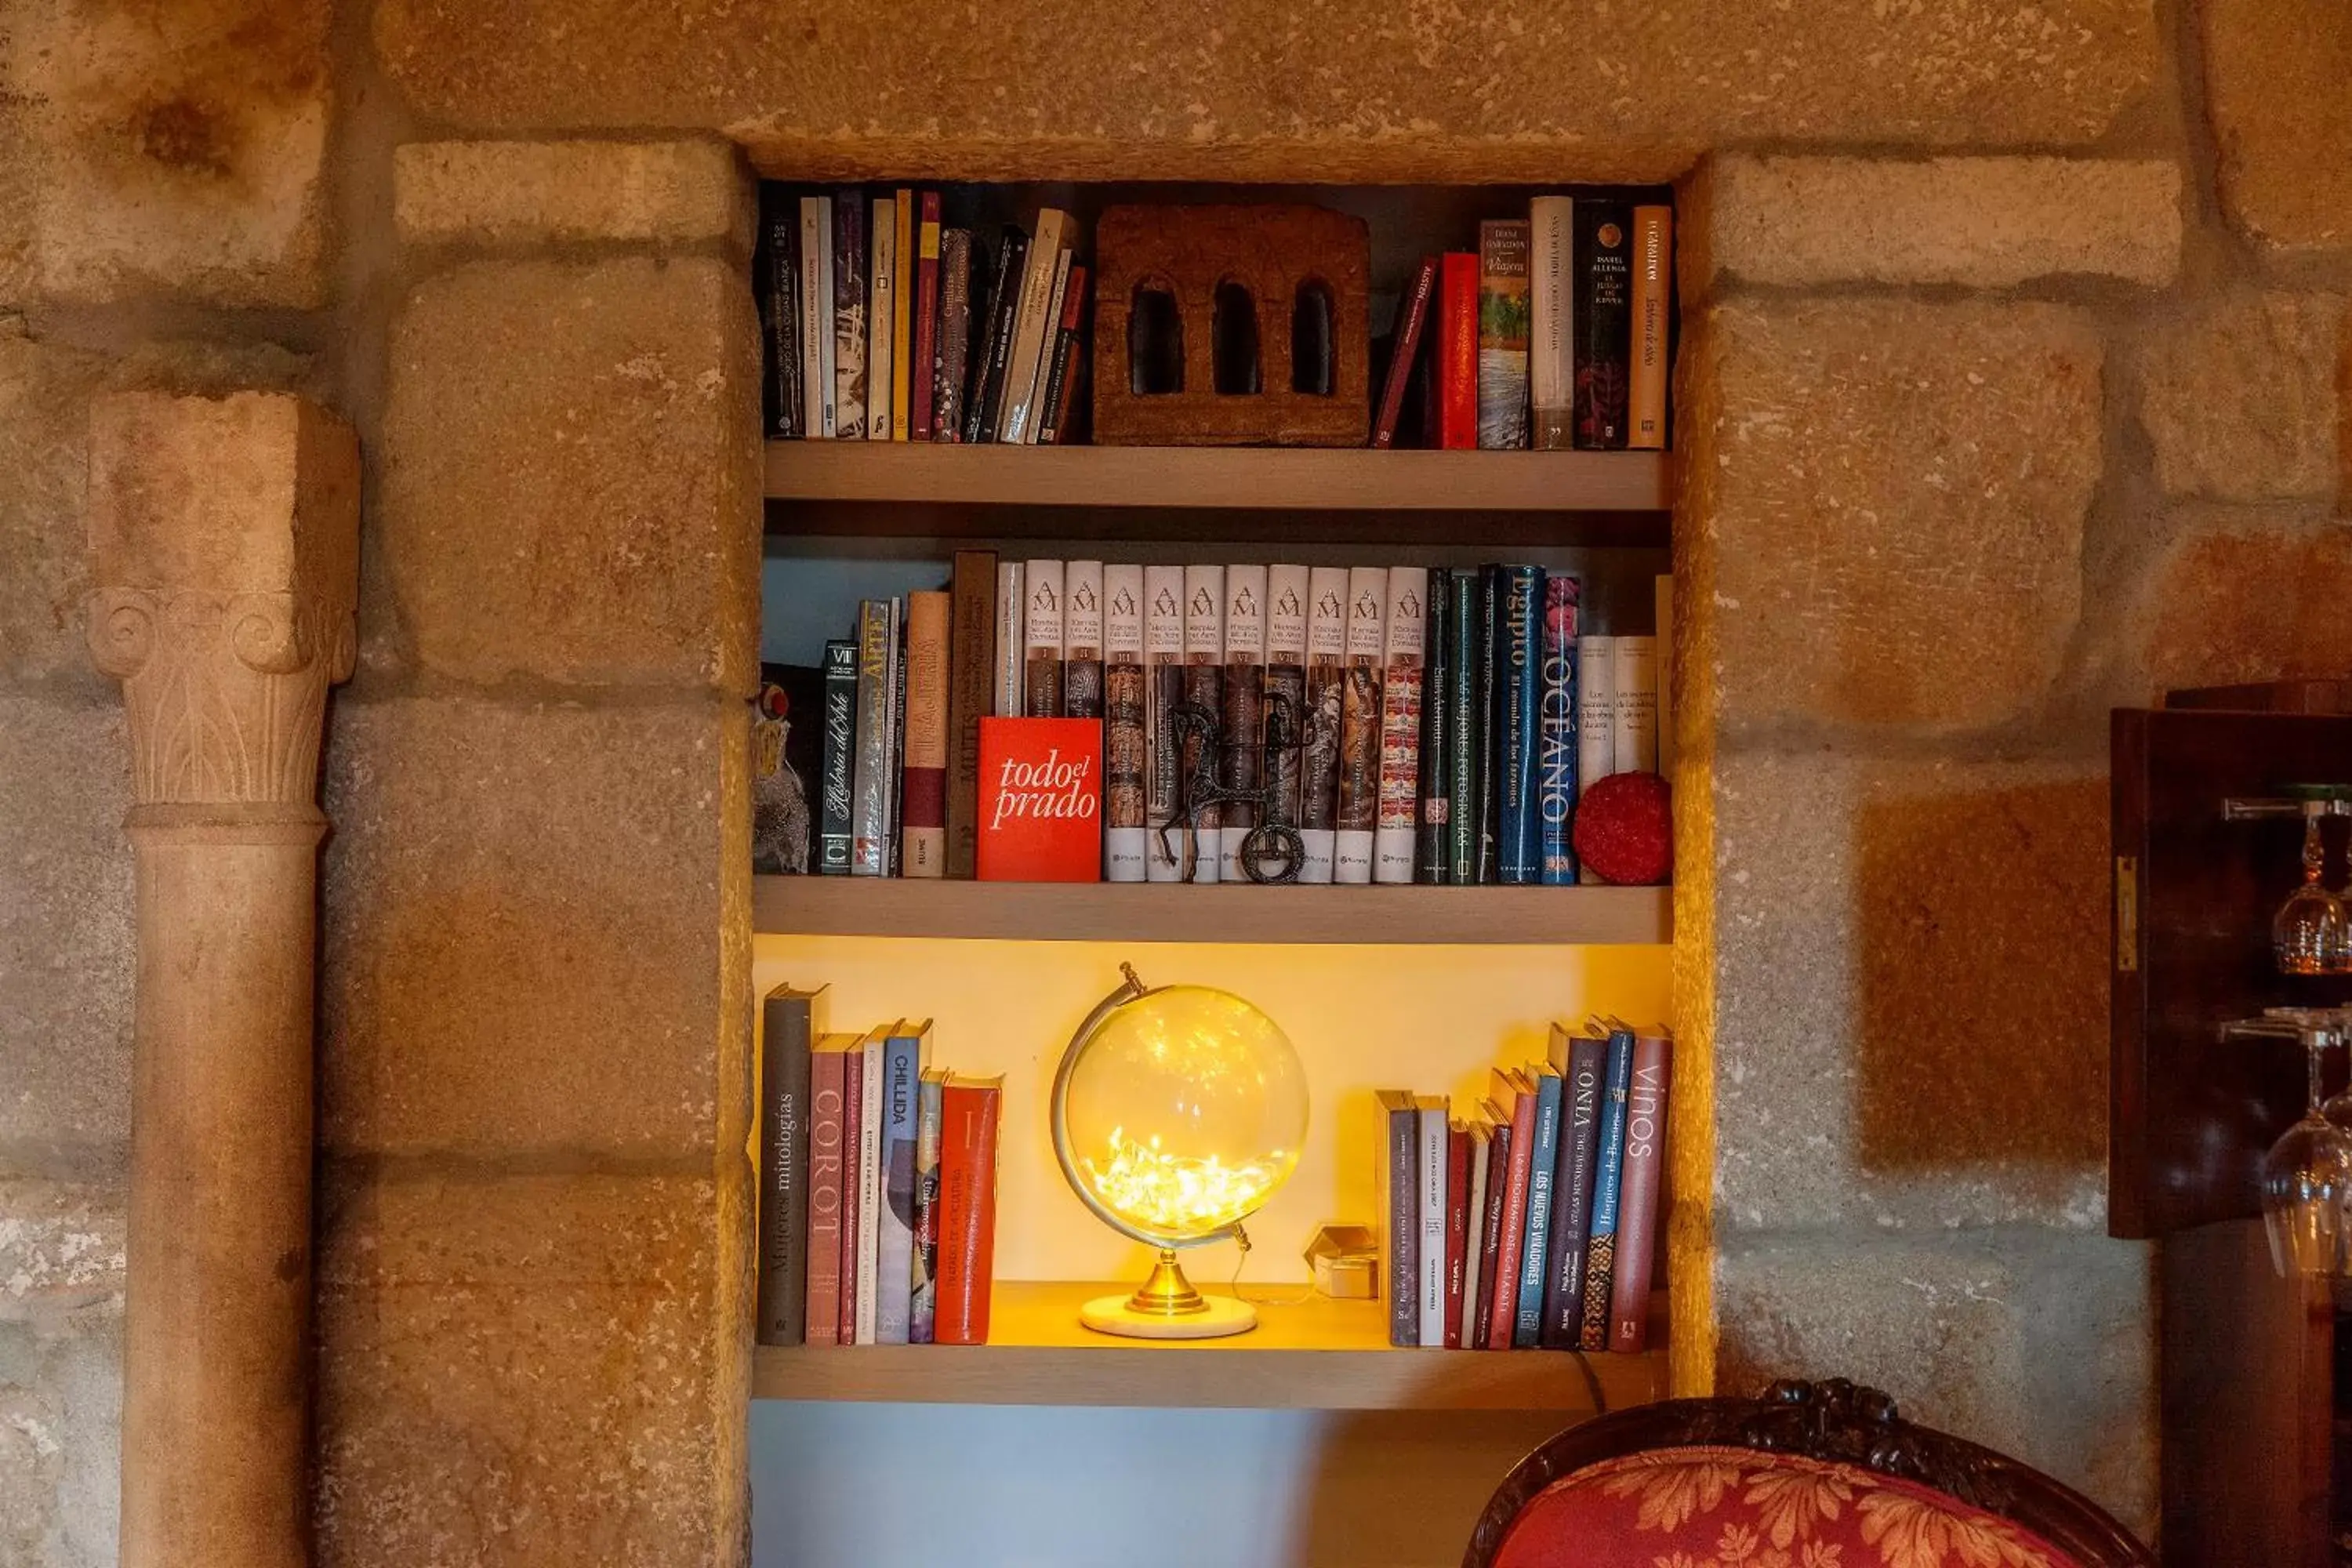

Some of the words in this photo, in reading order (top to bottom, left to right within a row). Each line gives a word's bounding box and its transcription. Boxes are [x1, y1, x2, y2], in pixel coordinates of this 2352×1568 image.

[1417, 266, 1430, 299] AUSTEN
[1507, 575, 1534, 666] Egipto
[863, 617, 885, 678] ARTE
[1118, 653, 1130, 662] III
[1358, 656, 1368, 665] IX
[1510, 676, 1519, 687] El
[829, 691, 851, 731] Arte
[1458, 696, 1470, 751] MEJORES
[1510, 690, 1520, 726] mundo
[829, 730, 849, 750] del
[1510, 729, 1520, 741] de
[1510, 744, 1520, 760] los
[1542, 655, 1576, 823] OCÉANO
[826, 753, 851, 820] Historia
[1000, 748, 1073, 787] todo
[1073, 755, 1091, 776] el
[989, 780, 1095, 830] prado
[1458, 754, 1472, 839] FOTOGRAFÍAS
[893, 1054, 909, 1125] CHILLIDA
[1573, 1071, 1594, 1128] VINO
[1629, 1065, 1665, 1157] vinos
[775, 1092, 796, 1190] mitologías
[1577, 1133, 1586, 1151] DEL
[812, 1089, 843, 1241] COROT
[1536, 1171, 1548, 1189] LOS
[1573, 1152, 1584, 1195] MUNDIAL
[1533, 1192, 1546, 1229] NUEVOS
[1570, 1196, 1581, 1227] ATLAS
[773, 1196, 793, 1273] Mujeres
